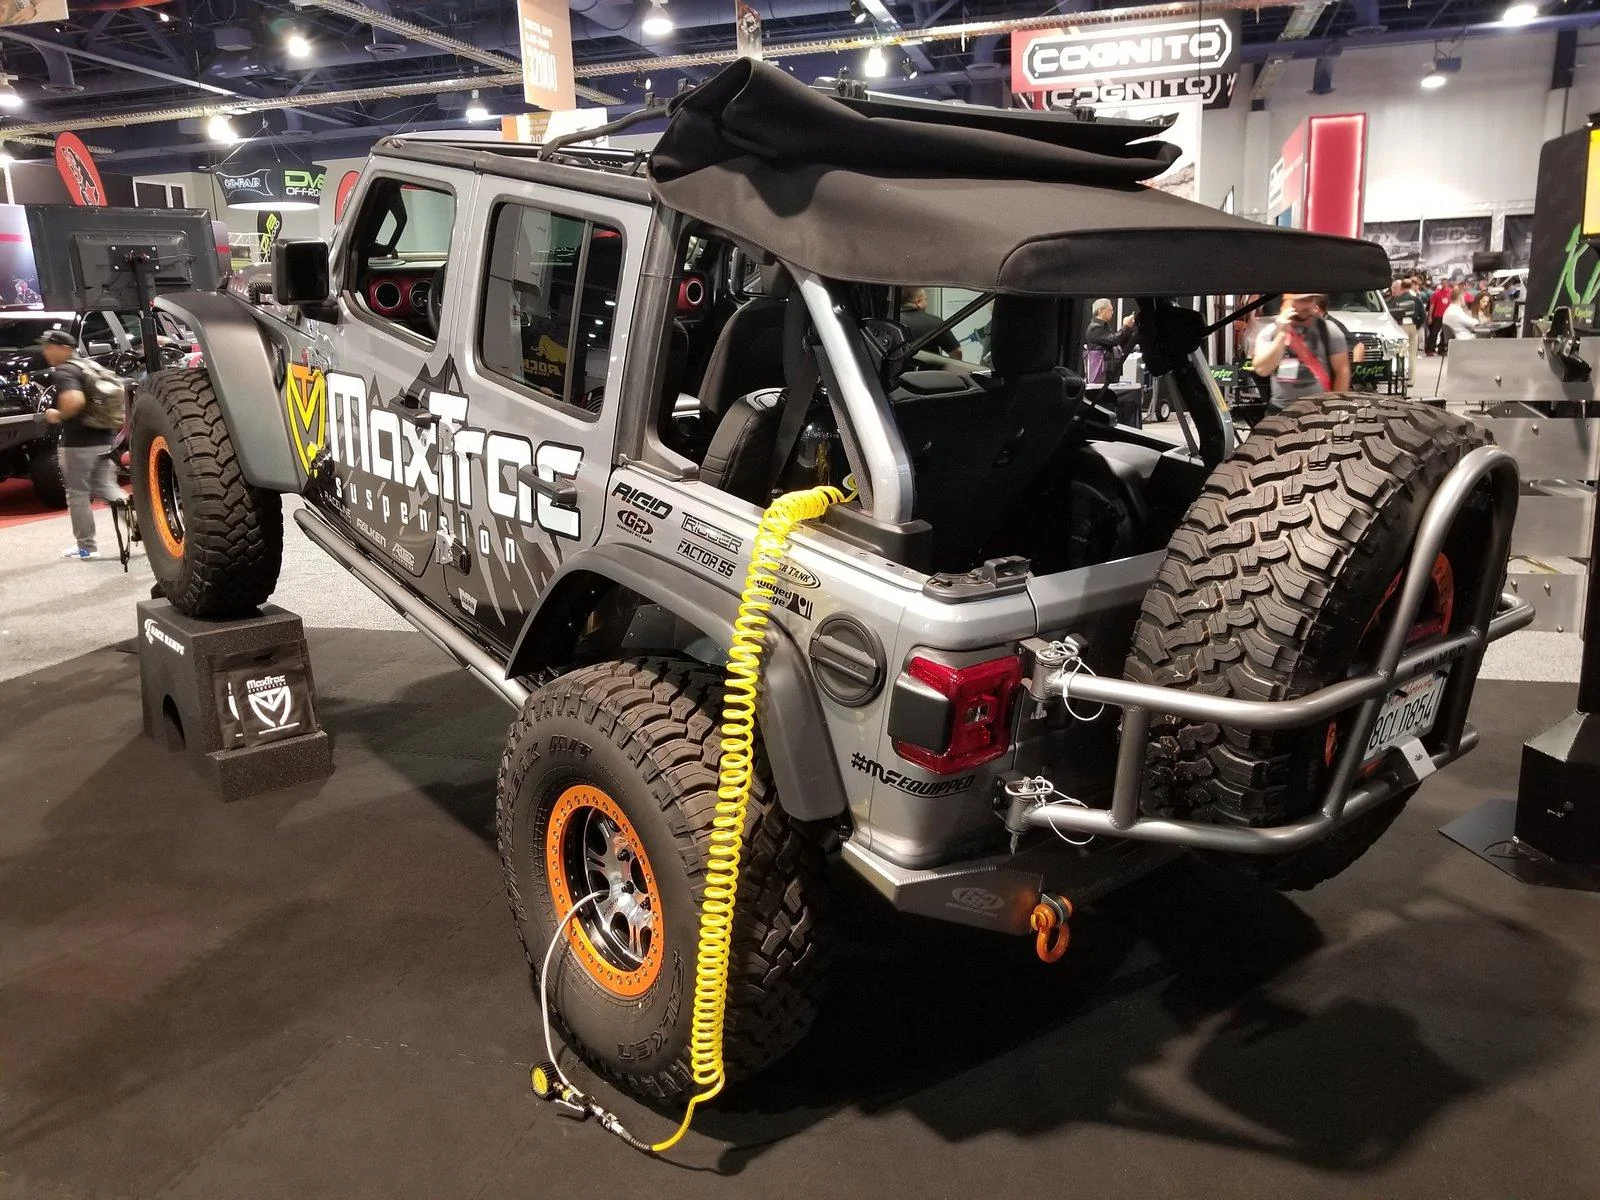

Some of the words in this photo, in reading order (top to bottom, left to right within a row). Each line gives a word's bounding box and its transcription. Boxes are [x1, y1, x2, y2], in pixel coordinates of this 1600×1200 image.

[1032, 32, 1221, 72] COGNITO
[1050, 75, 1212, 105] COGNITO
[611, 482, 674, 520] RIGID
[334, 476, 517, 566] suspension
[677, 540, 719, 571] FACTOR
[788, 566, 811, 583] TANK
